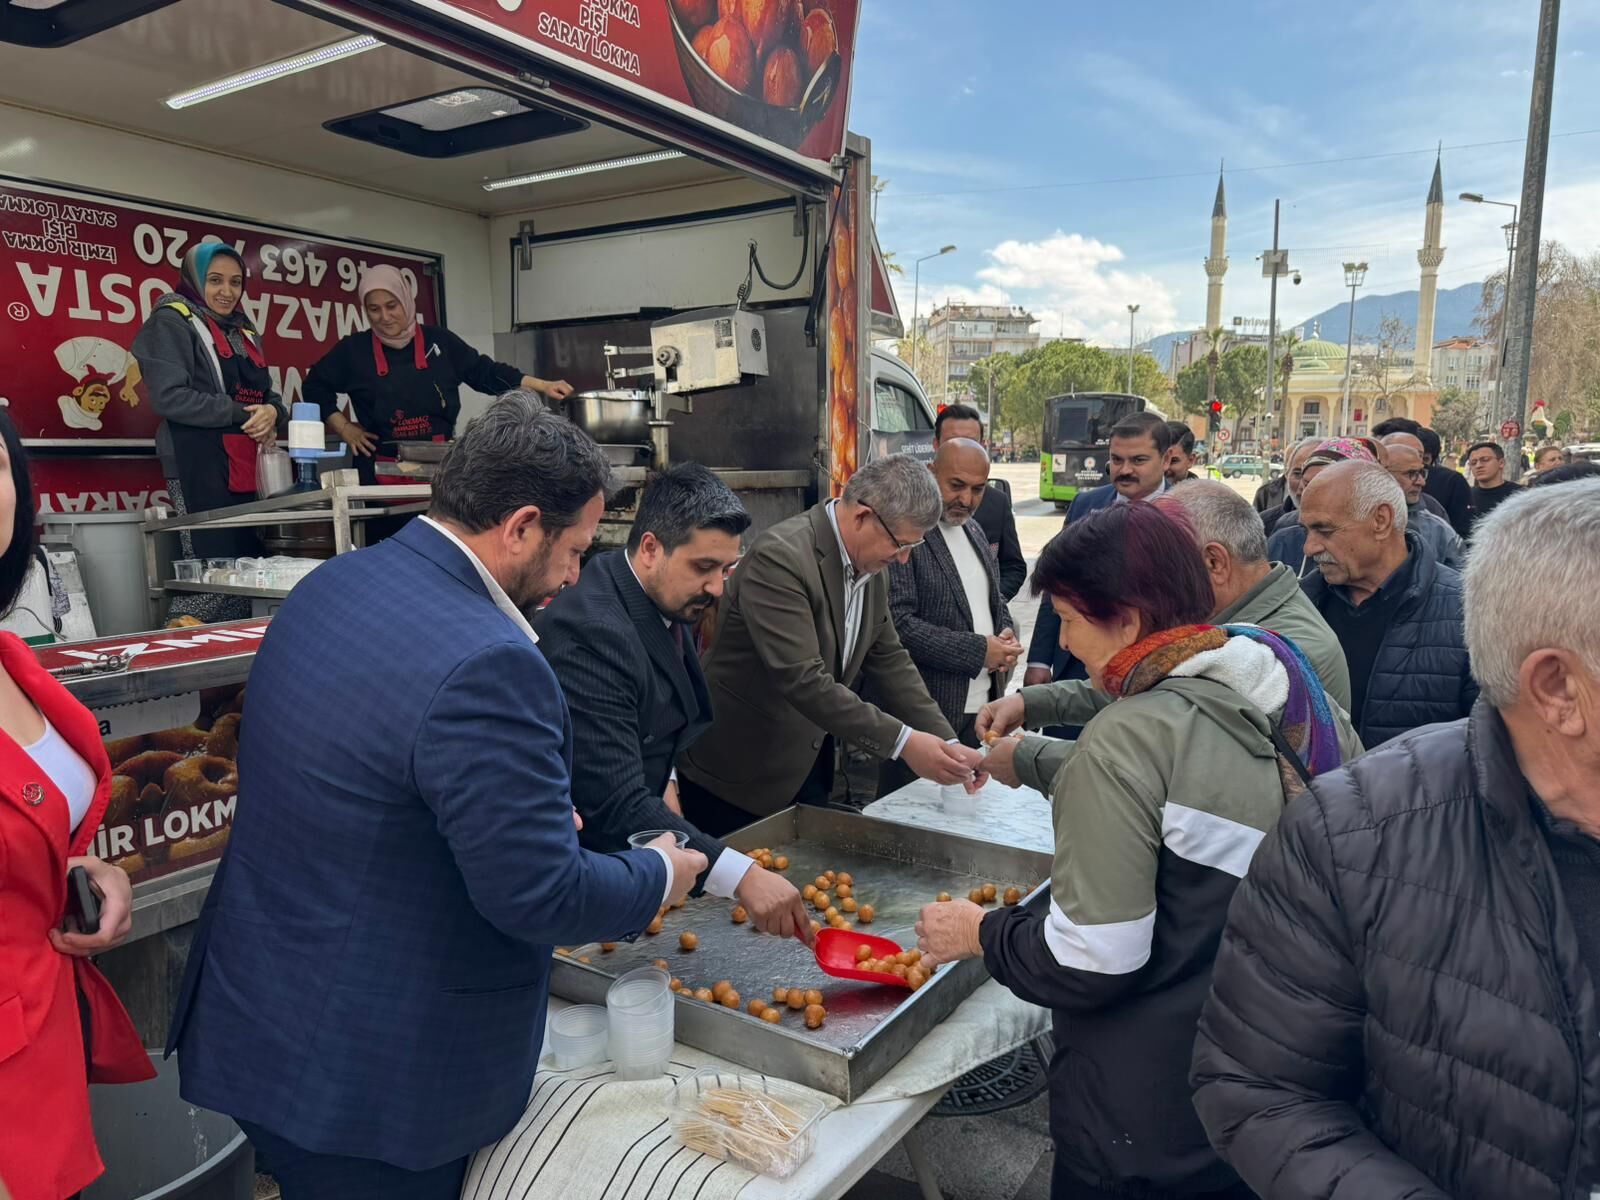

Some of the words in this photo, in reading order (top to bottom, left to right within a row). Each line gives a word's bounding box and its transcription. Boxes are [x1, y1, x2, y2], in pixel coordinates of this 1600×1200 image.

[579, 4, 608, 37] PİŞİ
[538, 12, 590, 52] SARAY
[591, 35, 640, 76] LOKMA
[43, 219, 77, 239] PİŞİ
[62, 204, 117, 227] SARAY
[2, 230, 68, 254] LOKMA
[70, 242, 117, 264] İZMİR
[133, 223, 188, 268] 20
[259, 243, 328, 287] 463
[144, 795, 238, 847] LOKM
